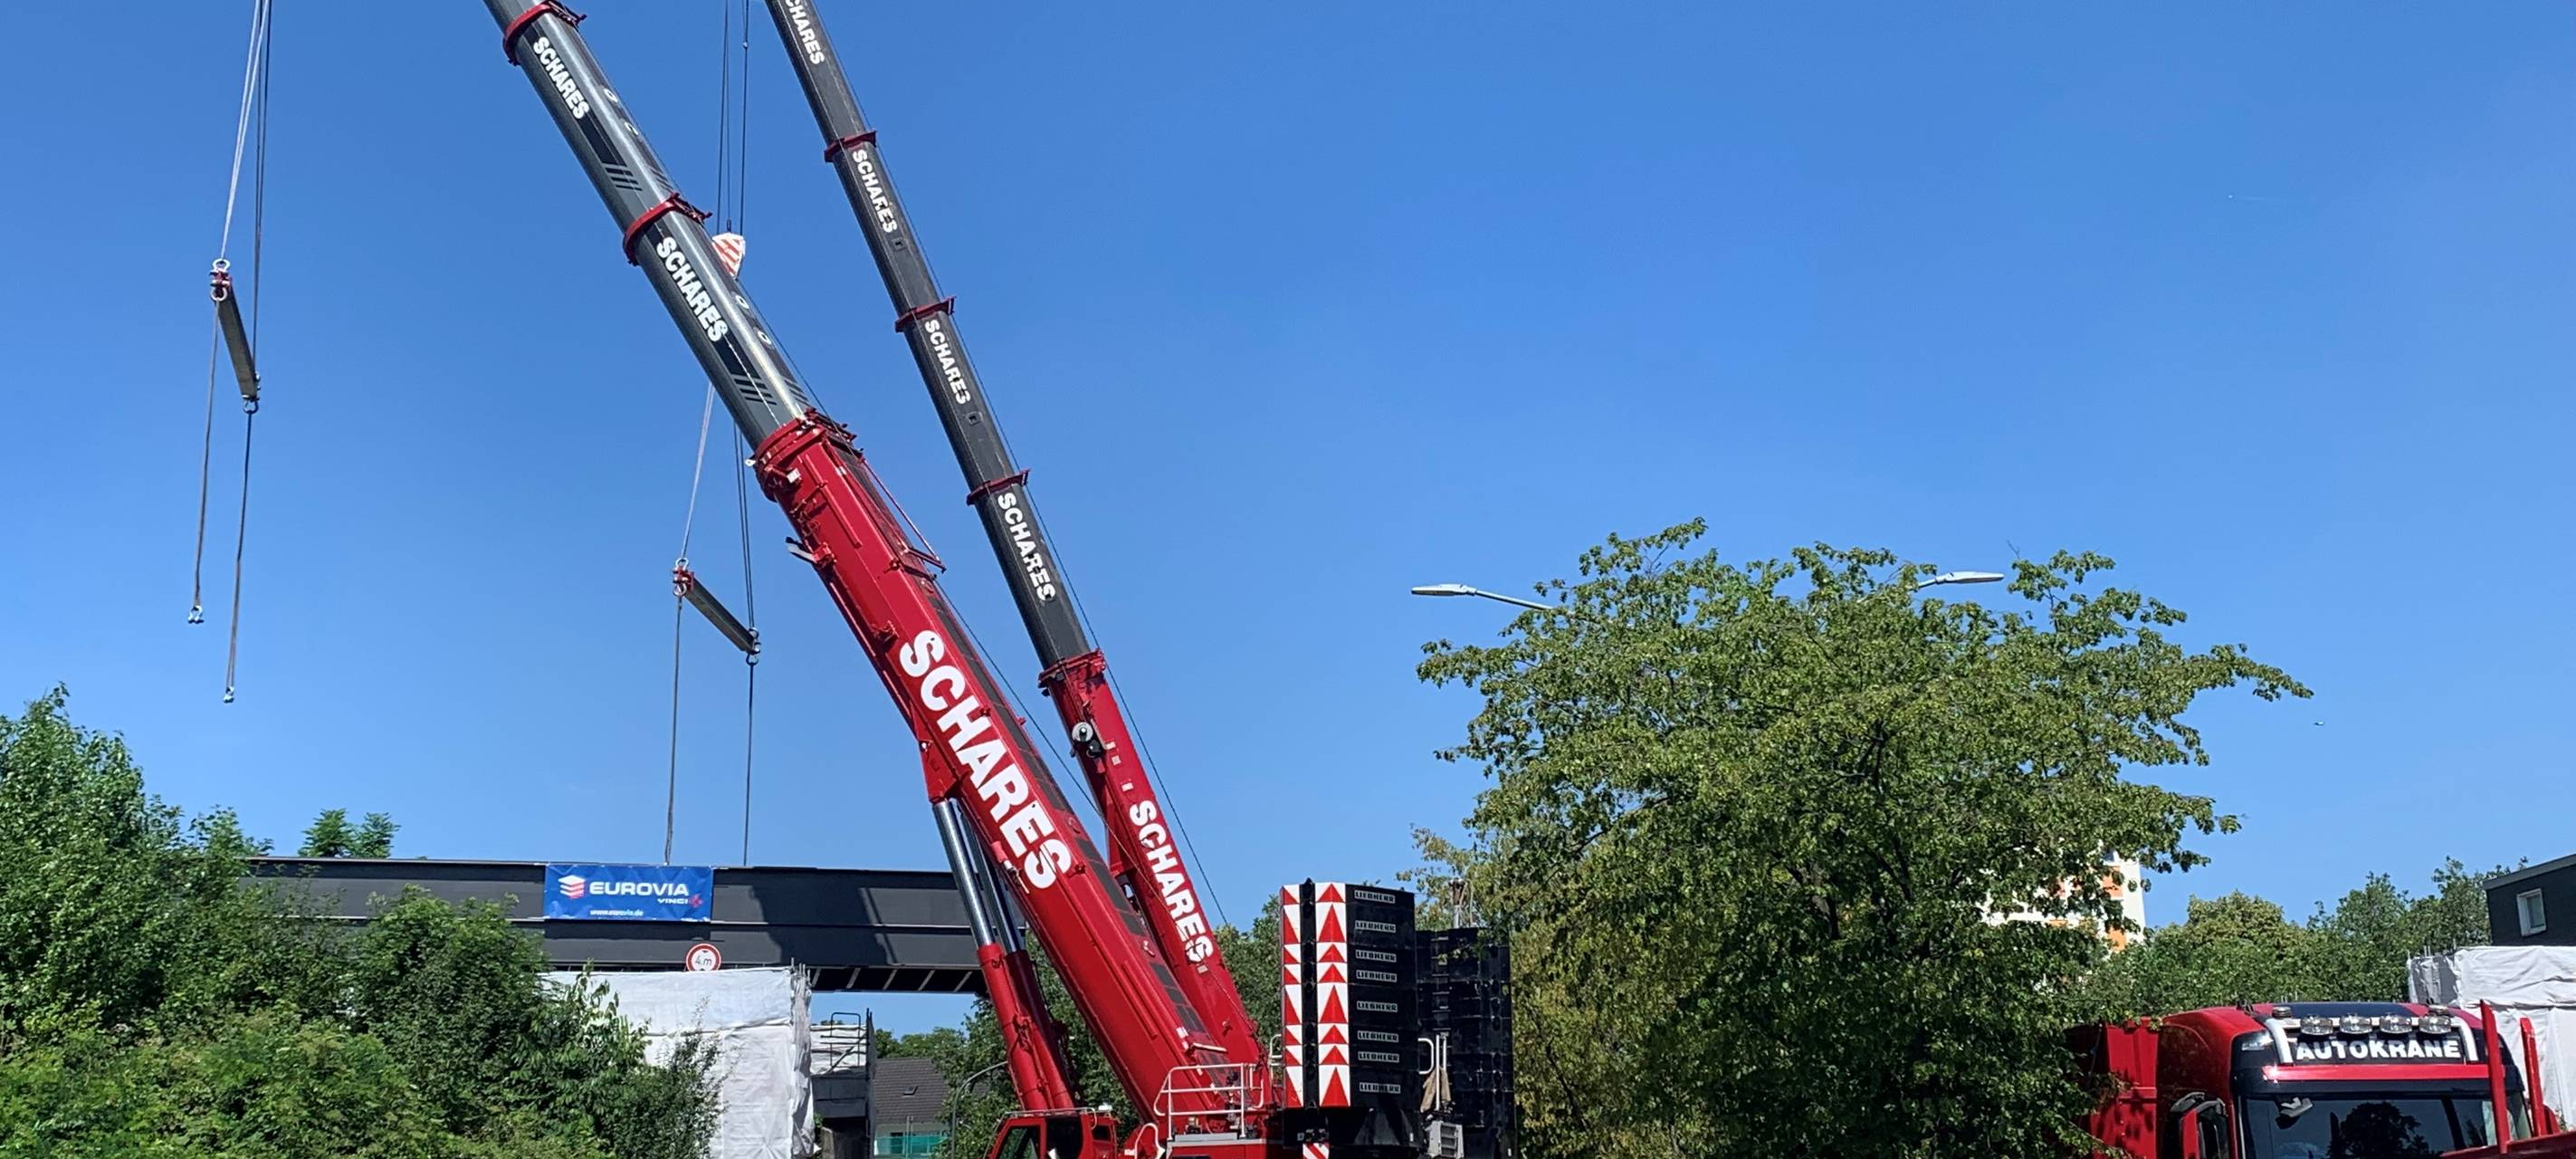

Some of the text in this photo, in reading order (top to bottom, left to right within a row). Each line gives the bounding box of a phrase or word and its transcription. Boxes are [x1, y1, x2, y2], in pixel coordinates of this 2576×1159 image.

[786, 0, 825, 64] CHARES
[533, 36, 589, 120] SCHARES
[852, 148, 898, 234] SCHARES
[656, 236, 728, 342] SCHARES
[924, 319, 971, 405] SCHARES
[997, 492, 1056, 601] SCHARES
[899, 629, 1072, 889] SCHARES
[589, 881, 689, 896] EUROVIA
[1129, 800, 1214, 963] SCHARES
[1355, 890, 1395, 903] LIEBHERR
[1355, 921, 1396, 932] LIEBHERR
[1356, 950, 1396, 962] LIEBHERR
[1357, 971, 1397, 982] LIEBHERR
[1358, 1001, 1397, 1012] LIEBHERR
[1358, 1030, 1398, 1042] LIEBHERR
[1359, 1051, 1398, 1062] LIEBHERR
[2295, 1039, 2461, 1060] AUTOKRANE
[1360, 1083, 1399, 1094] LIEBHERR
